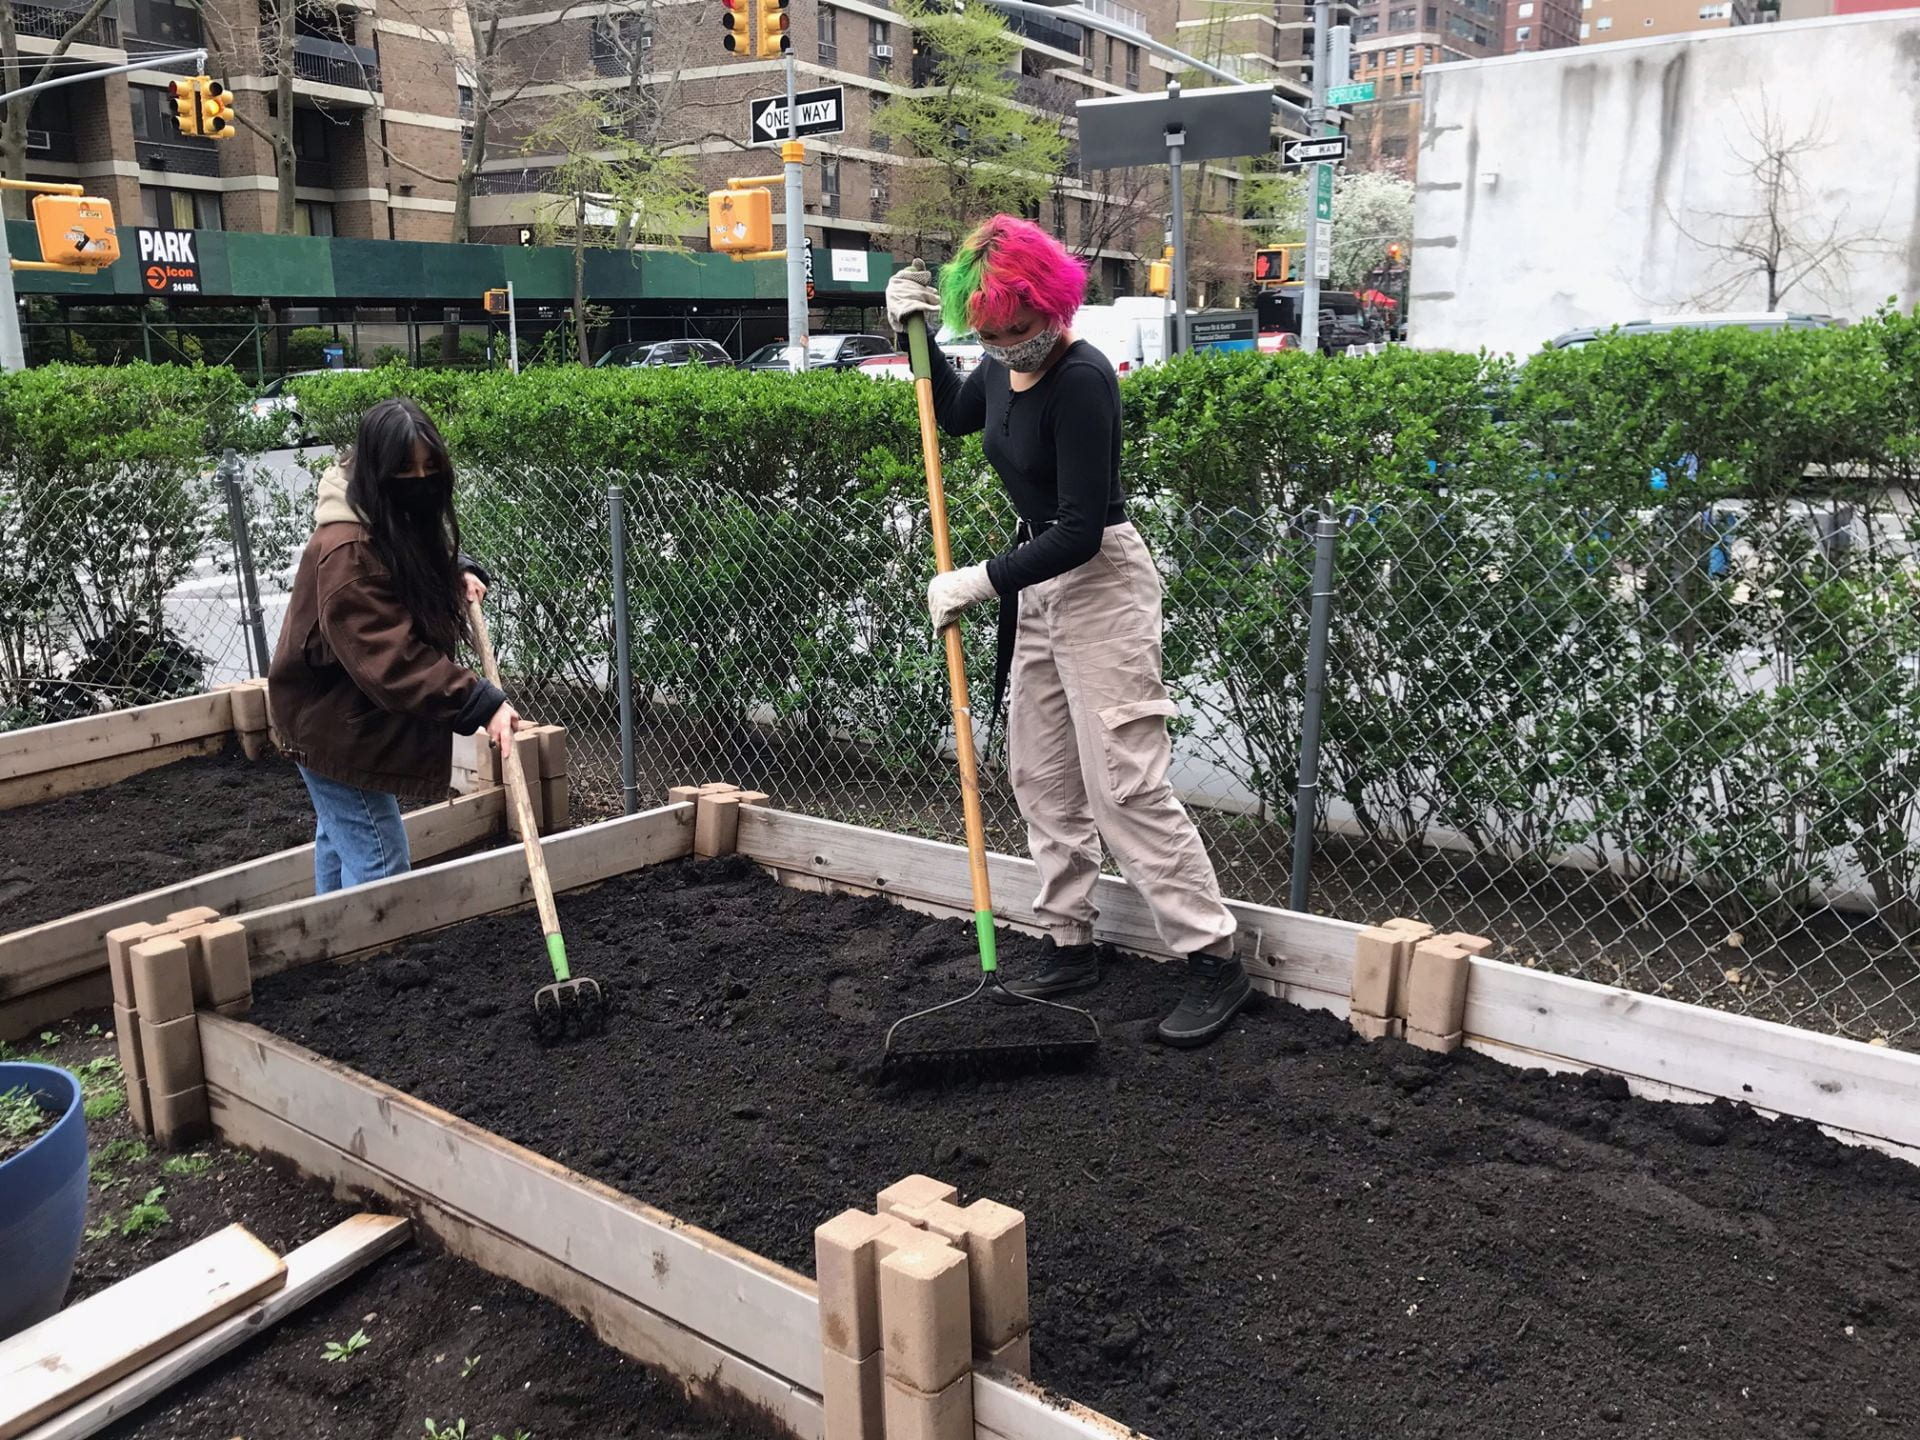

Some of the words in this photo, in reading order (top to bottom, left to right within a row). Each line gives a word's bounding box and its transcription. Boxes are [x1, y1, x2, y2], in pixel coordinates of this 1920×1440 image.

[765, 109, 789, 128] ONE
[802, 103, 830, 123] WAY
[1292, 147, 1310, 157] ONE
[1319, 144, 1338, 154] WAY
[139, 230, 195, 263] PARK
[166, 265, 194, 277] icon
[172, 283, 182, 292] 24
